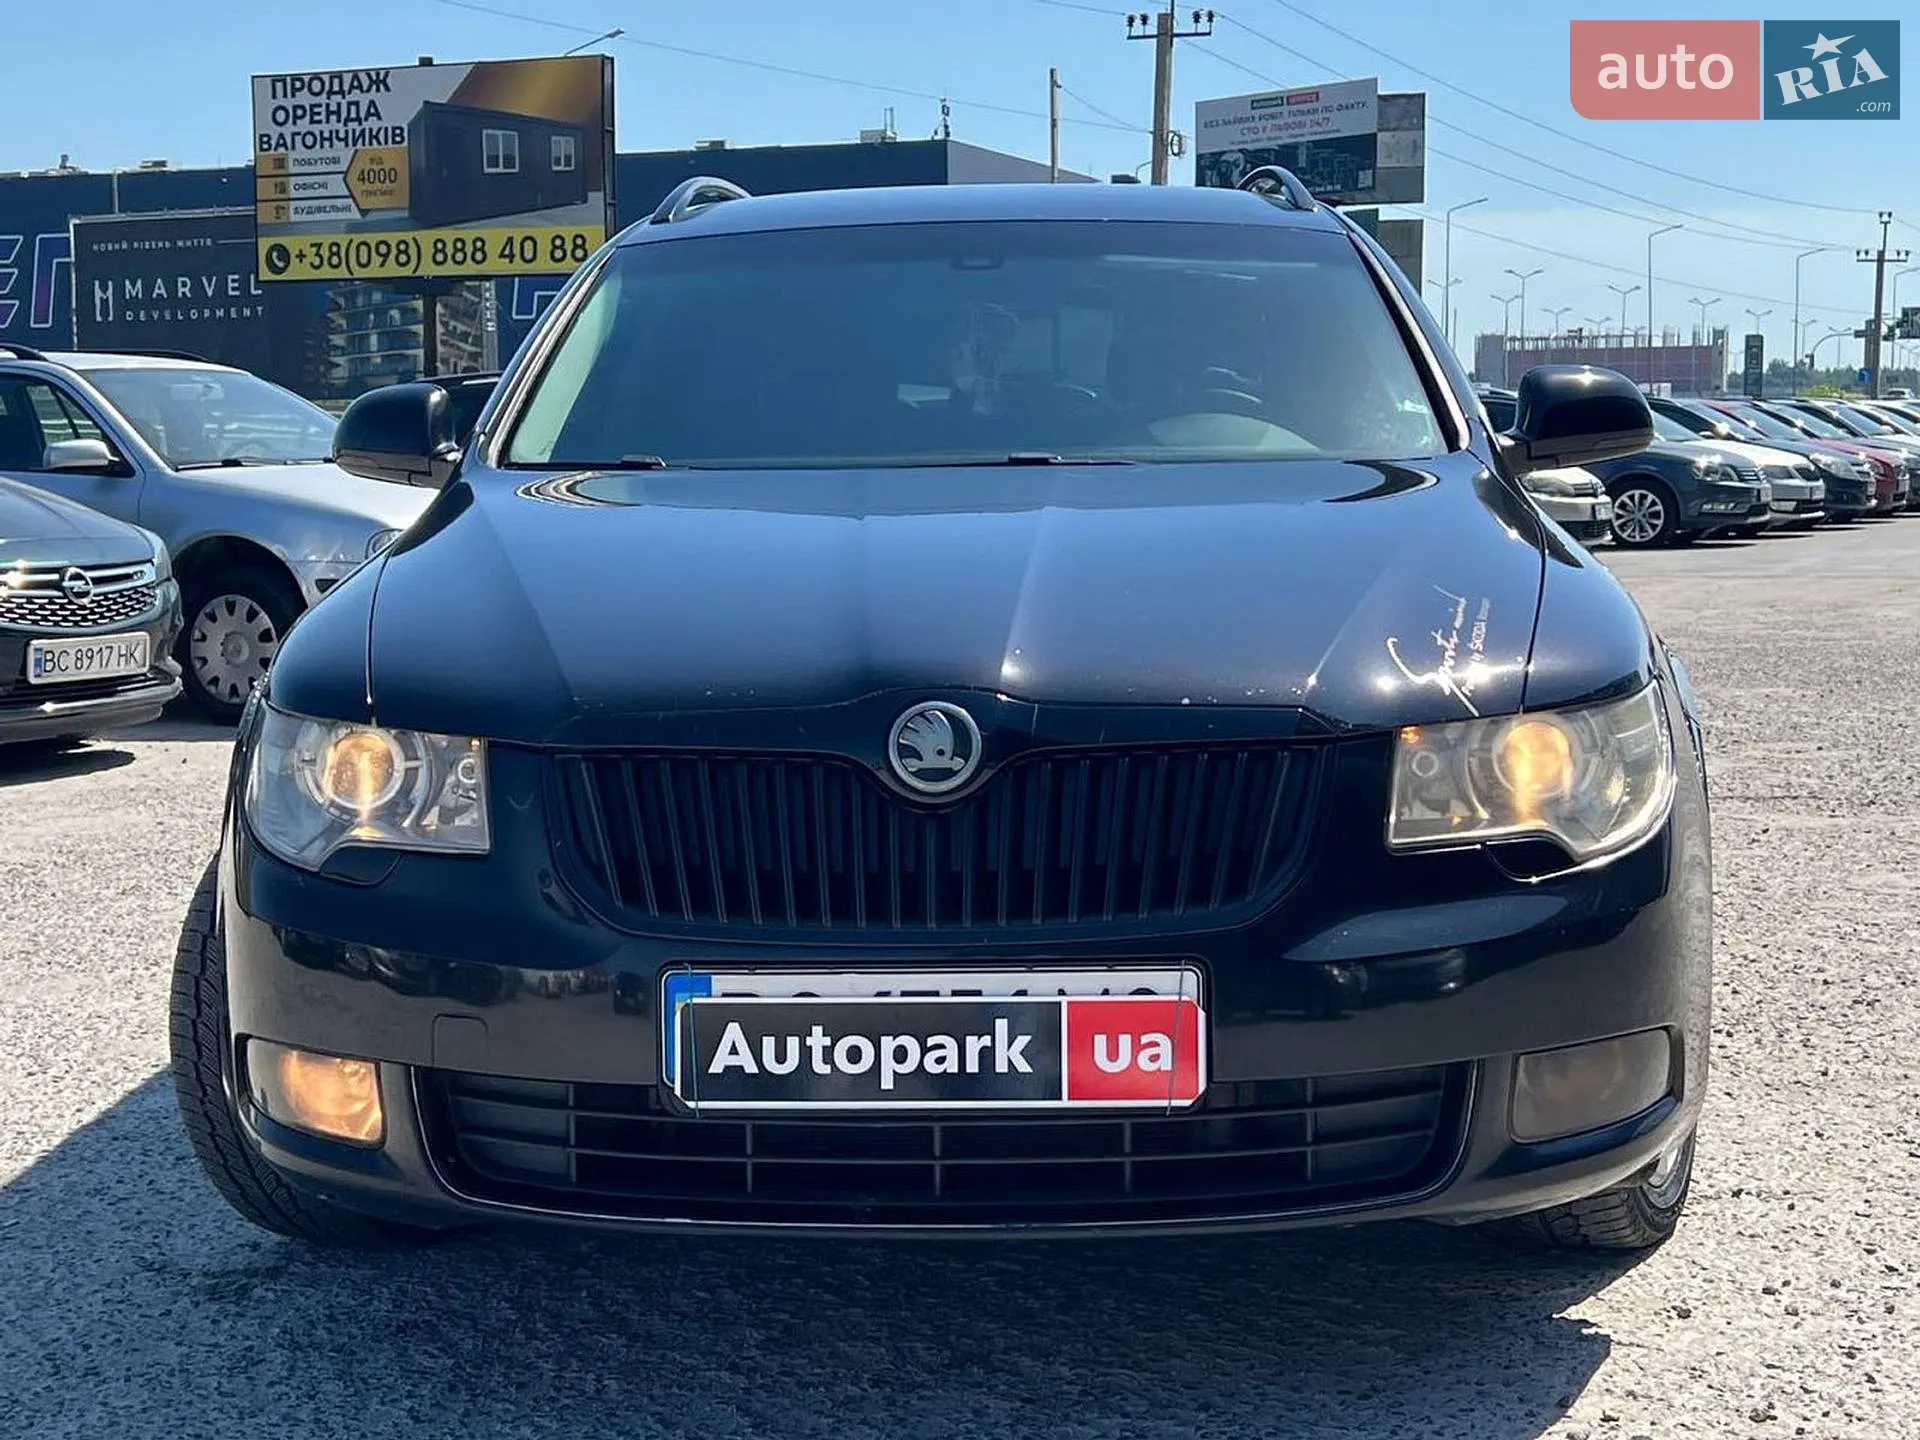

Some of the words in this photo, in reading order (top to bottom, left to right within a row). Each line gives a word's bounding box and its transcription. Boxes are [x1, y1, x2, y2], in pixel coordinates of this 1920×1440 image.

[271, 70, 391, 100] ПРОДАЖ
[271, 100, 382, 127] ОРЕНДА
[258, 125, 405, 152] ВАГОНЧИКІВ
[292, 156, 341, 167] ПОБУТОВІ
[292, 181, 329, 192] ОФІСНІ
[357, 167, 398, 185] 4000
[294, 236, 422, 276] +38(098)
[431, 236, 487, 267] 888
[499, 234, 538, 265] 40
[549, 233, 588, 264] 88
[125, 274, 263, 300] MARVEL
[125, 306, 264, 321] DEVELOPMENT
[74, 645, 114, 670] 8917
[708, 1018, 1034, 1090] Autopark
[1092, 1031, 1174, 1072] ua
